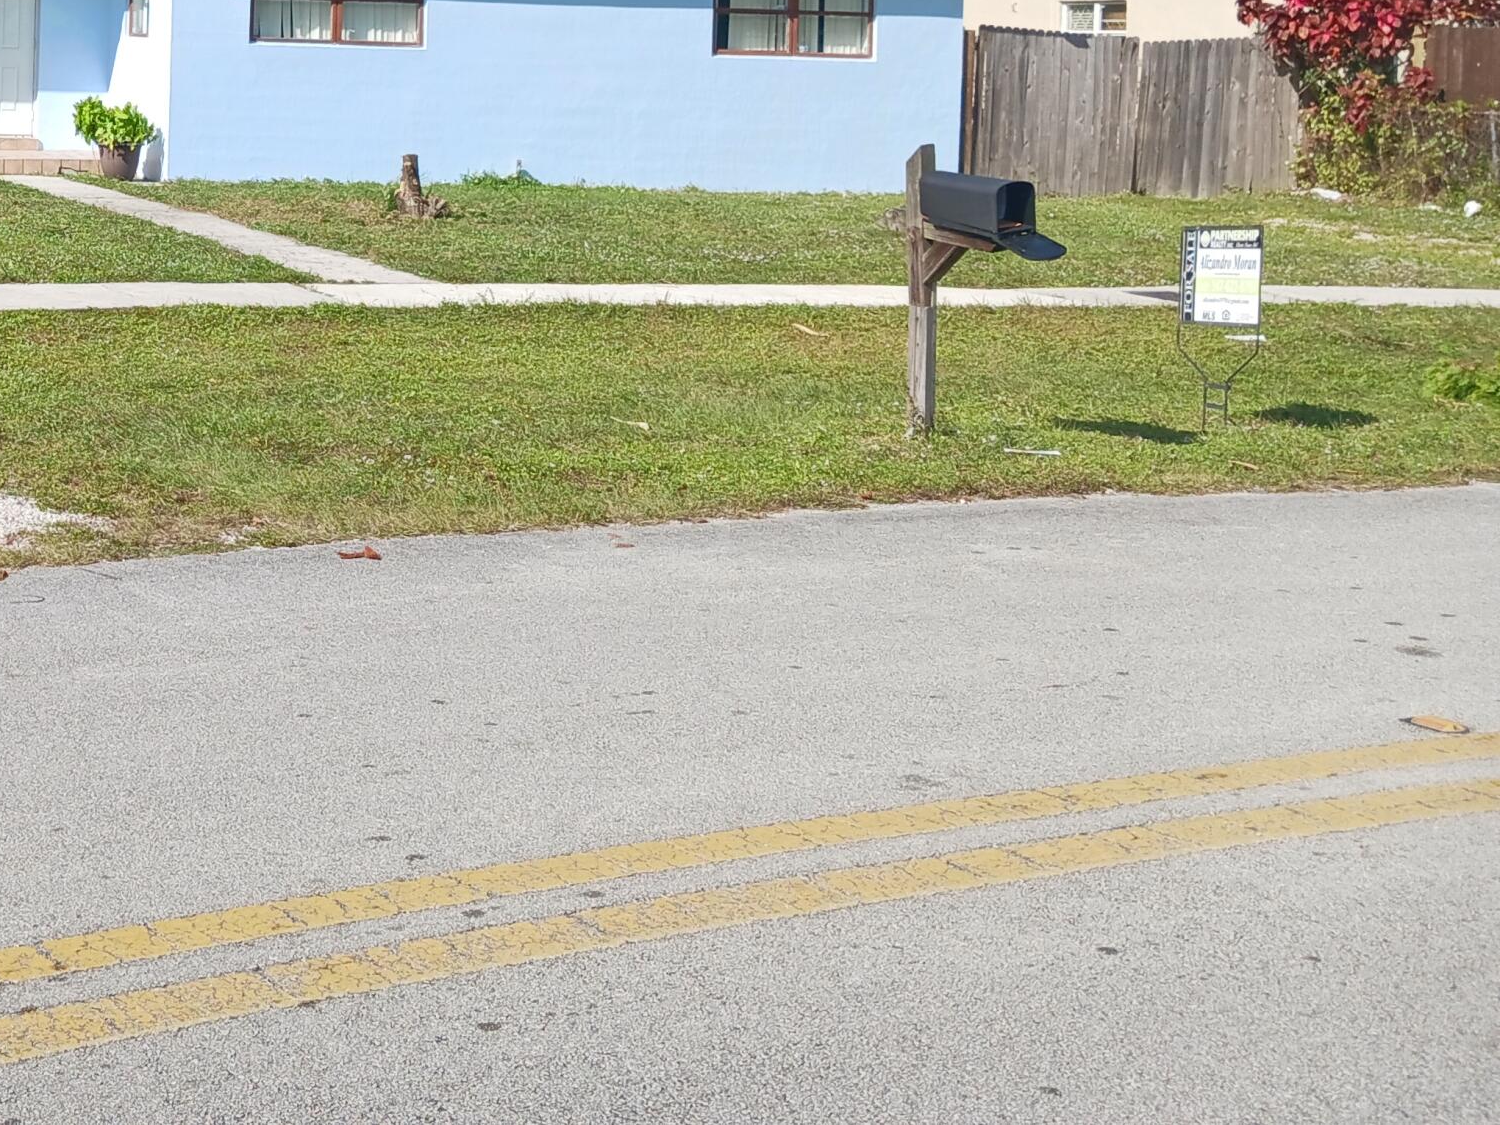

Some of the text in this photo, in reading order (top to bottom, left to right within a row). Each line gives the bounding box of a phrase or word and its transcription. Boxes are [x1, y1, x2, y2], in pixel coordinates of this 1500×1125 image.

[1210, 229, 1260, 241] PARTNERSHIP
[1233, 254, 1257, 271] Moran
[1184, 231, 1196, 312] FOR SALE
[1202, 310, 1216, 320] MLS
